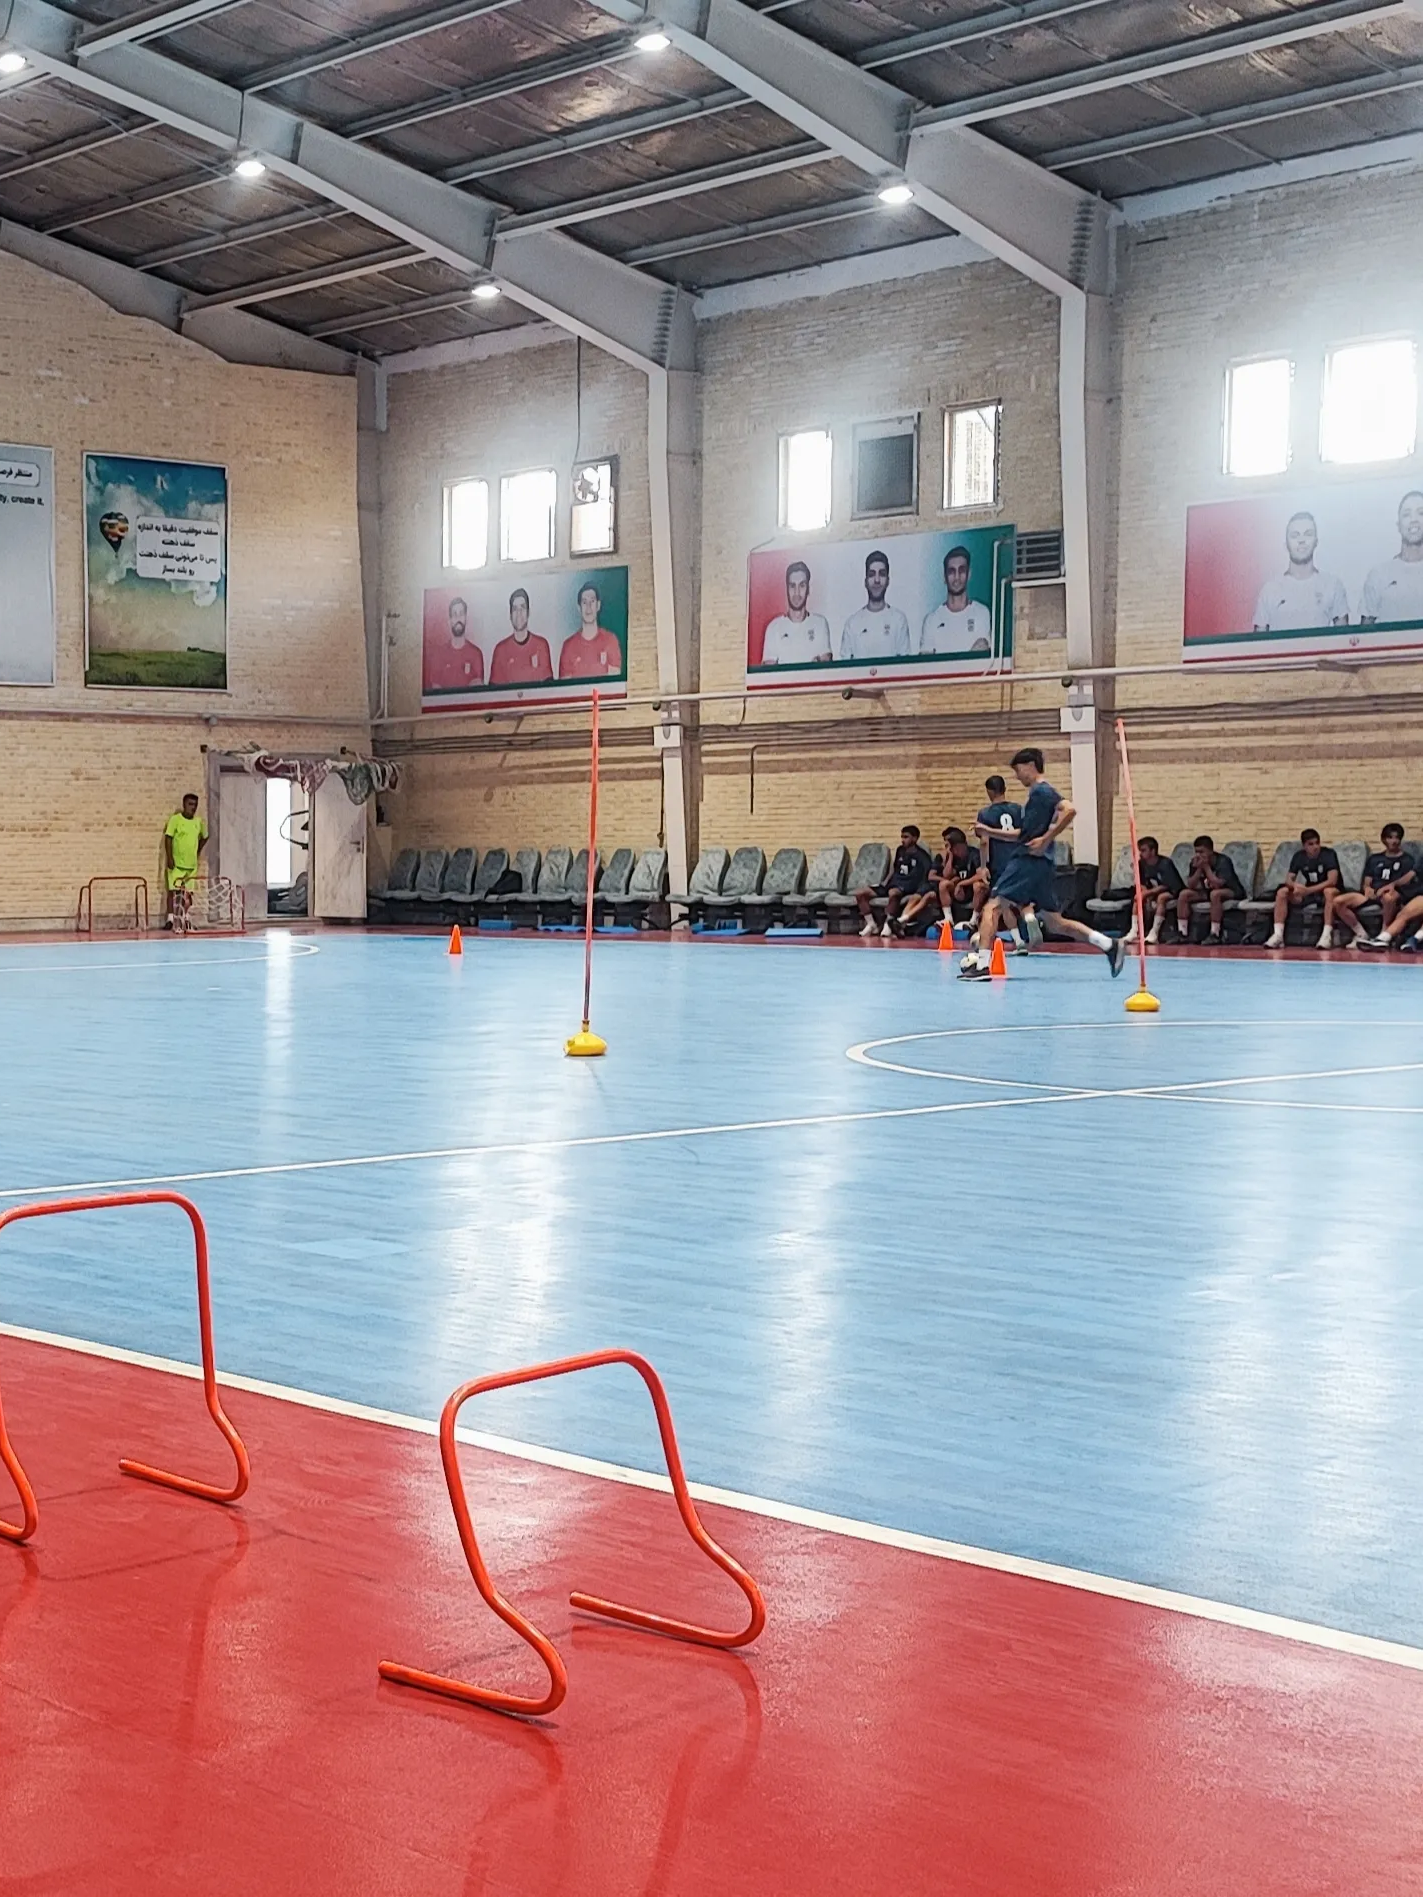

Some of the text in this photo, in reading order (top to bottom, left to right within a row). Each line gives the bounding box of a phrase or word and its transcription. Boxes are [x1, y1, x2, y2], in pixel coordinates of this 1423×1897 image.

[14, 468, 33, 478] منتظر
[11, 496, 35, 504] create
[137, 524, 153, 532] اندازه
[179, 526, 201, 536] موفقیت
[1000, 813, 1015, 832] 8
